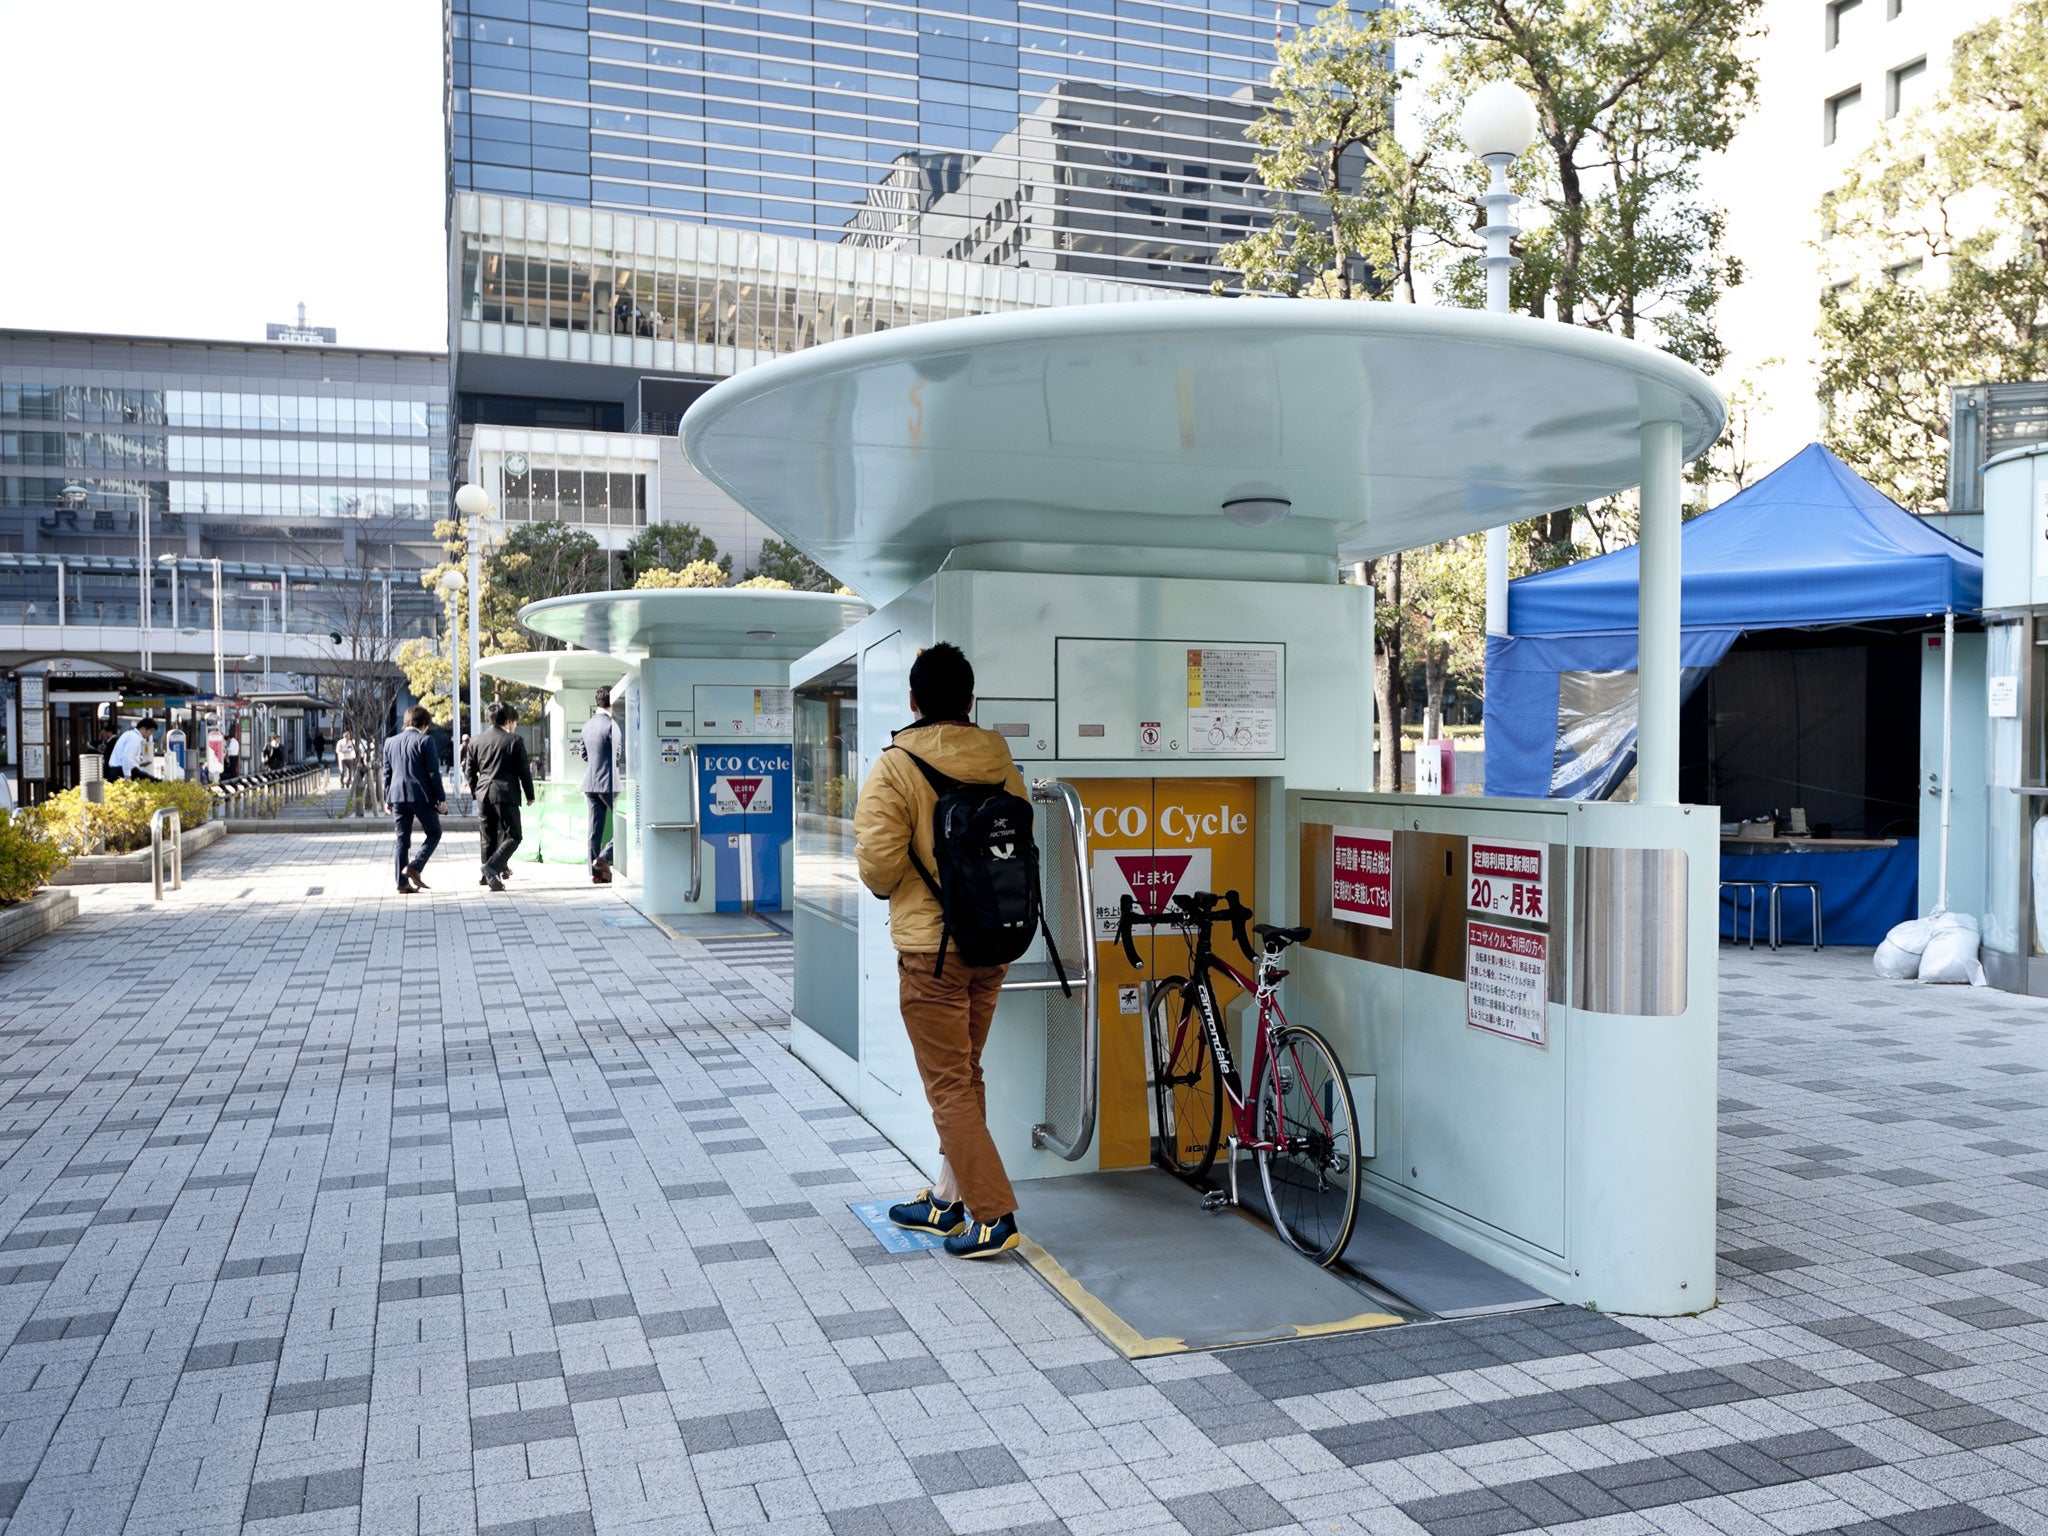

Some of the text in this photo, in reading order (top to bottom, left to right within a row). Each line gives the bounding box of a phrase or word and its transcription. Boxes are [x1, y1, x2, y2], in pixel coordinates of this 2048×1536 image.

[40, 509, 79, 532] JR
[704, 757, 790, 773] ECO Cycle
[734, 785, 755, 793] 止まれ
[1160, 805, 1248, 843] Cycle
[1335, 846, 1390, 875] 車両整備・車両点検は
[1474, 851, 1539, 874] 定期利用更新期間
[1132, 871, 1176, 886] 止まれ
[1334, 879, 1391, 908] 定期的に実施して下さい
[1470, 929, 1545, 956] エコサイクルご利用の方へ
[1198, 984, 1230, 1074] cannondale
